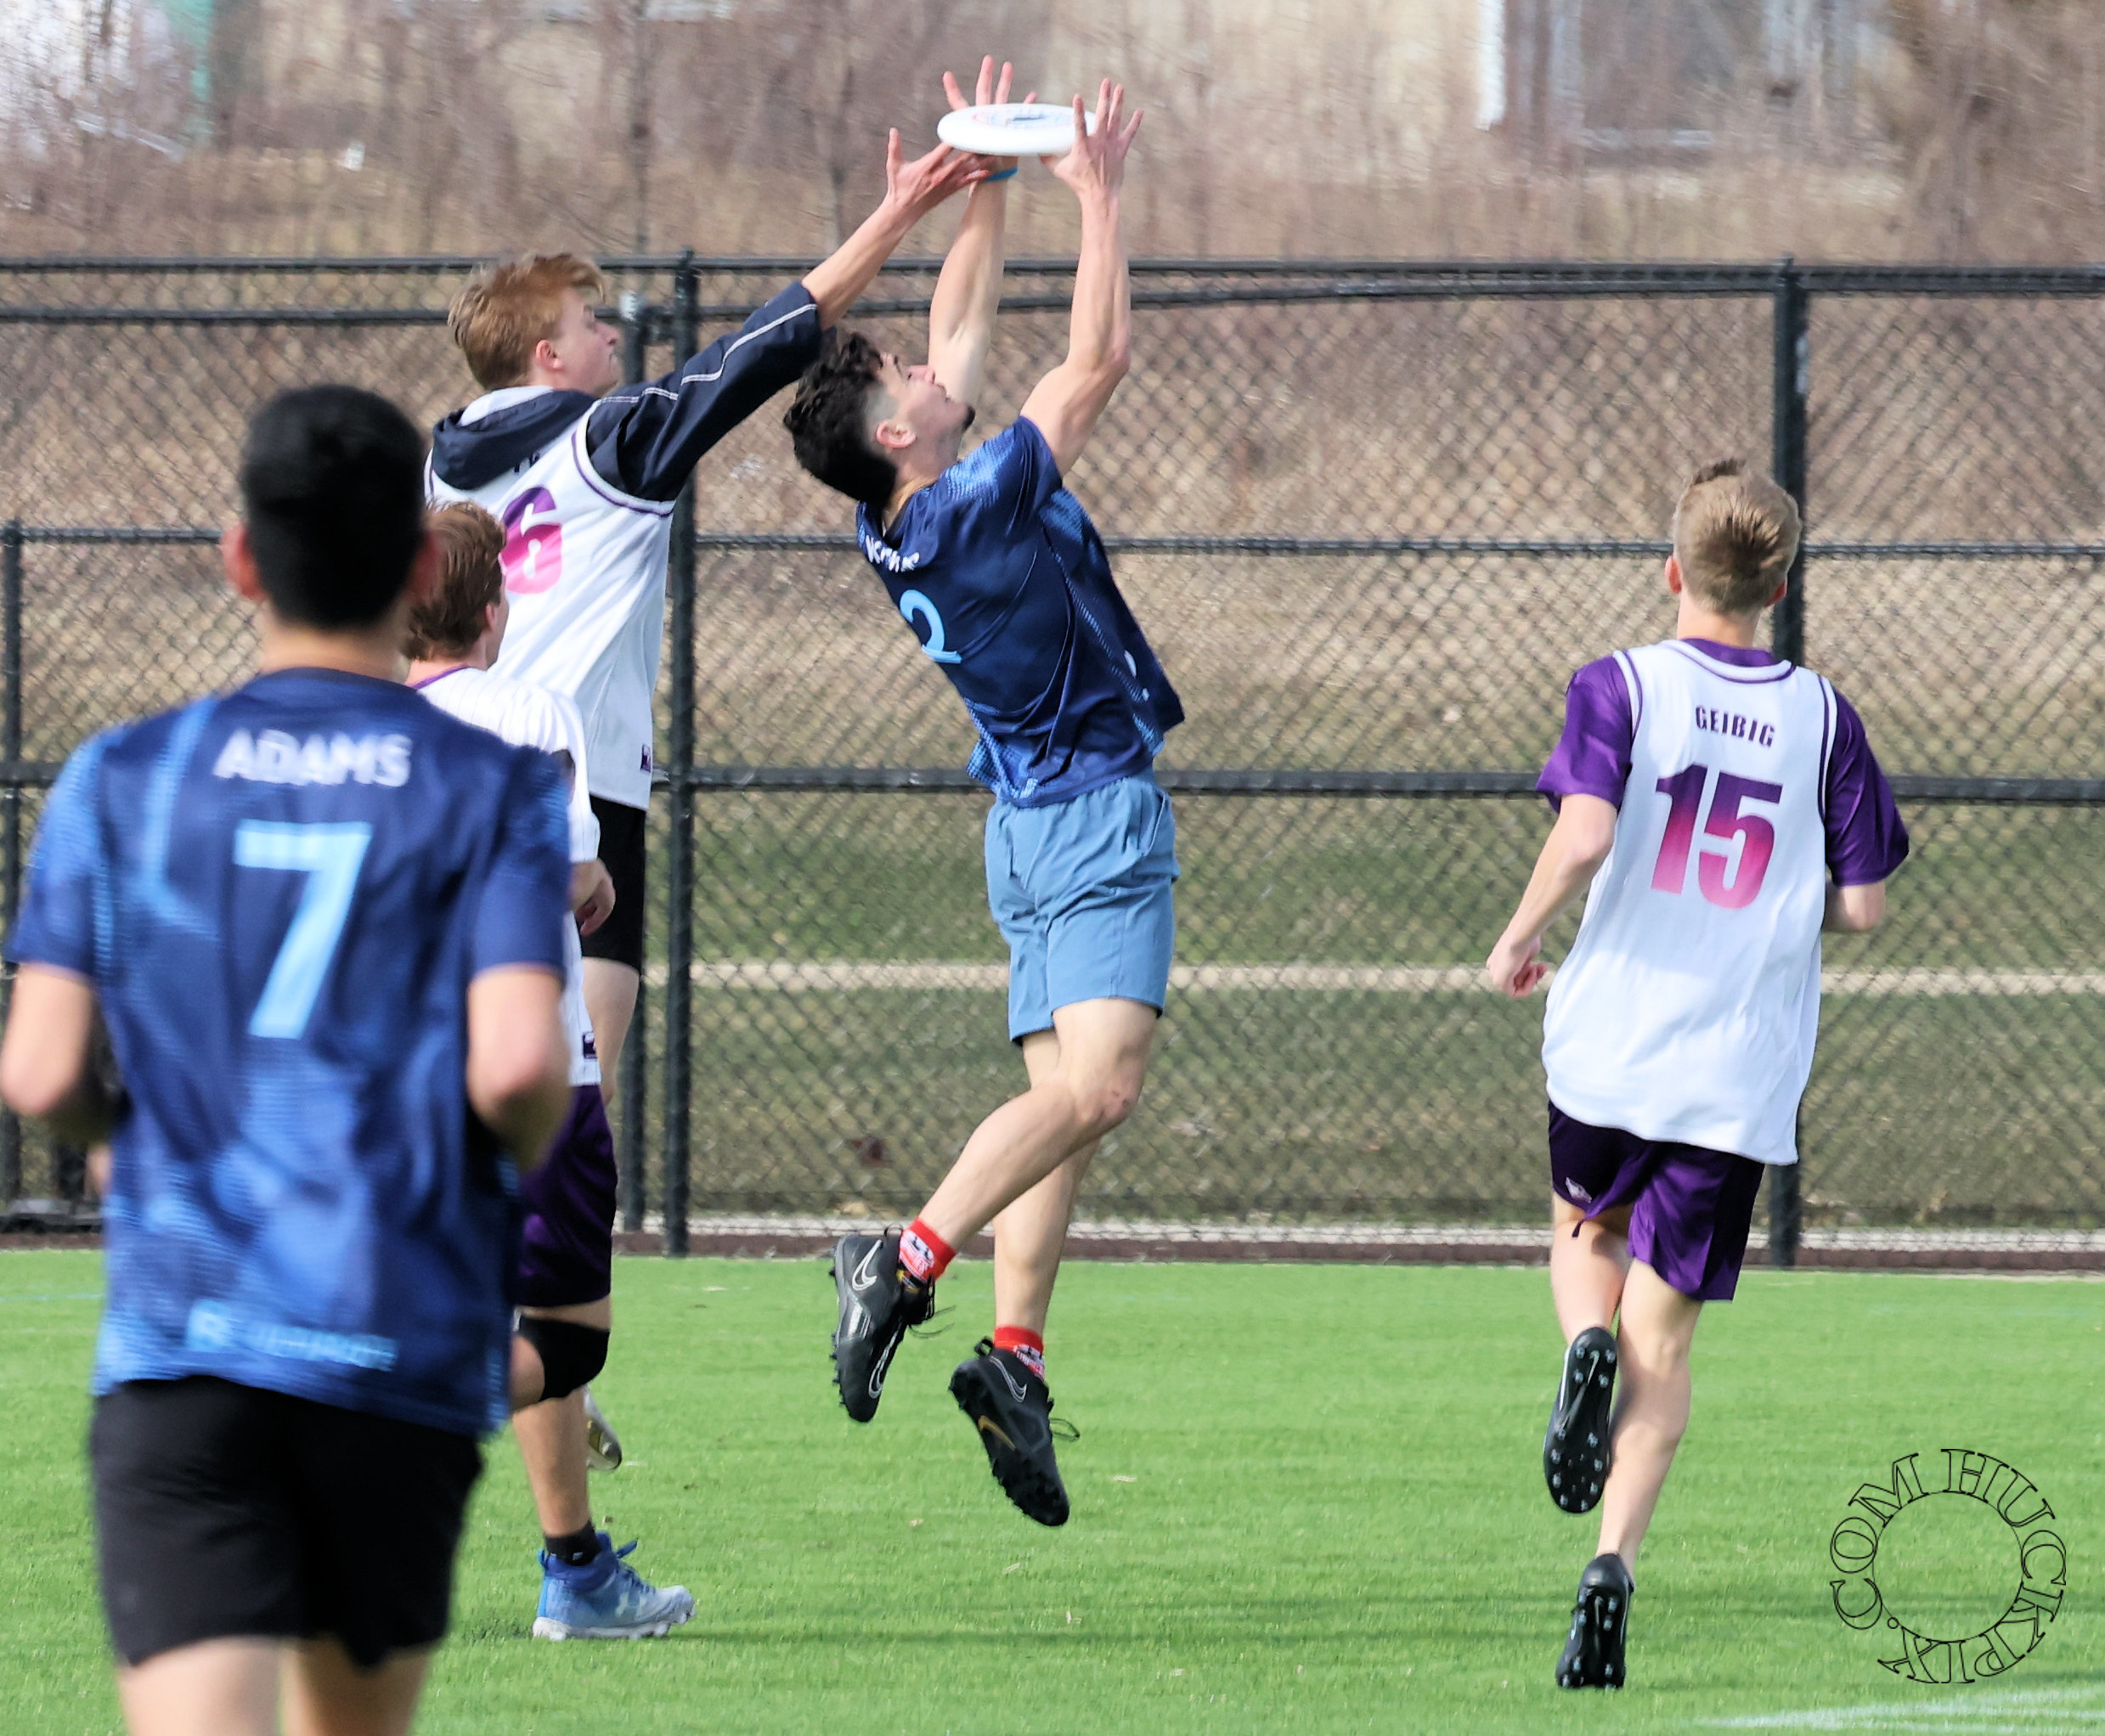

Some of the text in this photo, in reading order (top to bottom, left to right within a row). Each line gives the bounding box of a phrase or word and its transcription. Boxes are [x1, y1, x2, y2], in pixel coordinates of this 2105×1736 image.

[501, 486, 562, 595] 6
[900, 589, 962, 664] 2
[213, 730, 411, 786] ADAMS
[1696, 706, 1775, 747] GEIBIG
[1651, 762, 1783, 910] 15
[233, 819, 372, 1040] 7
